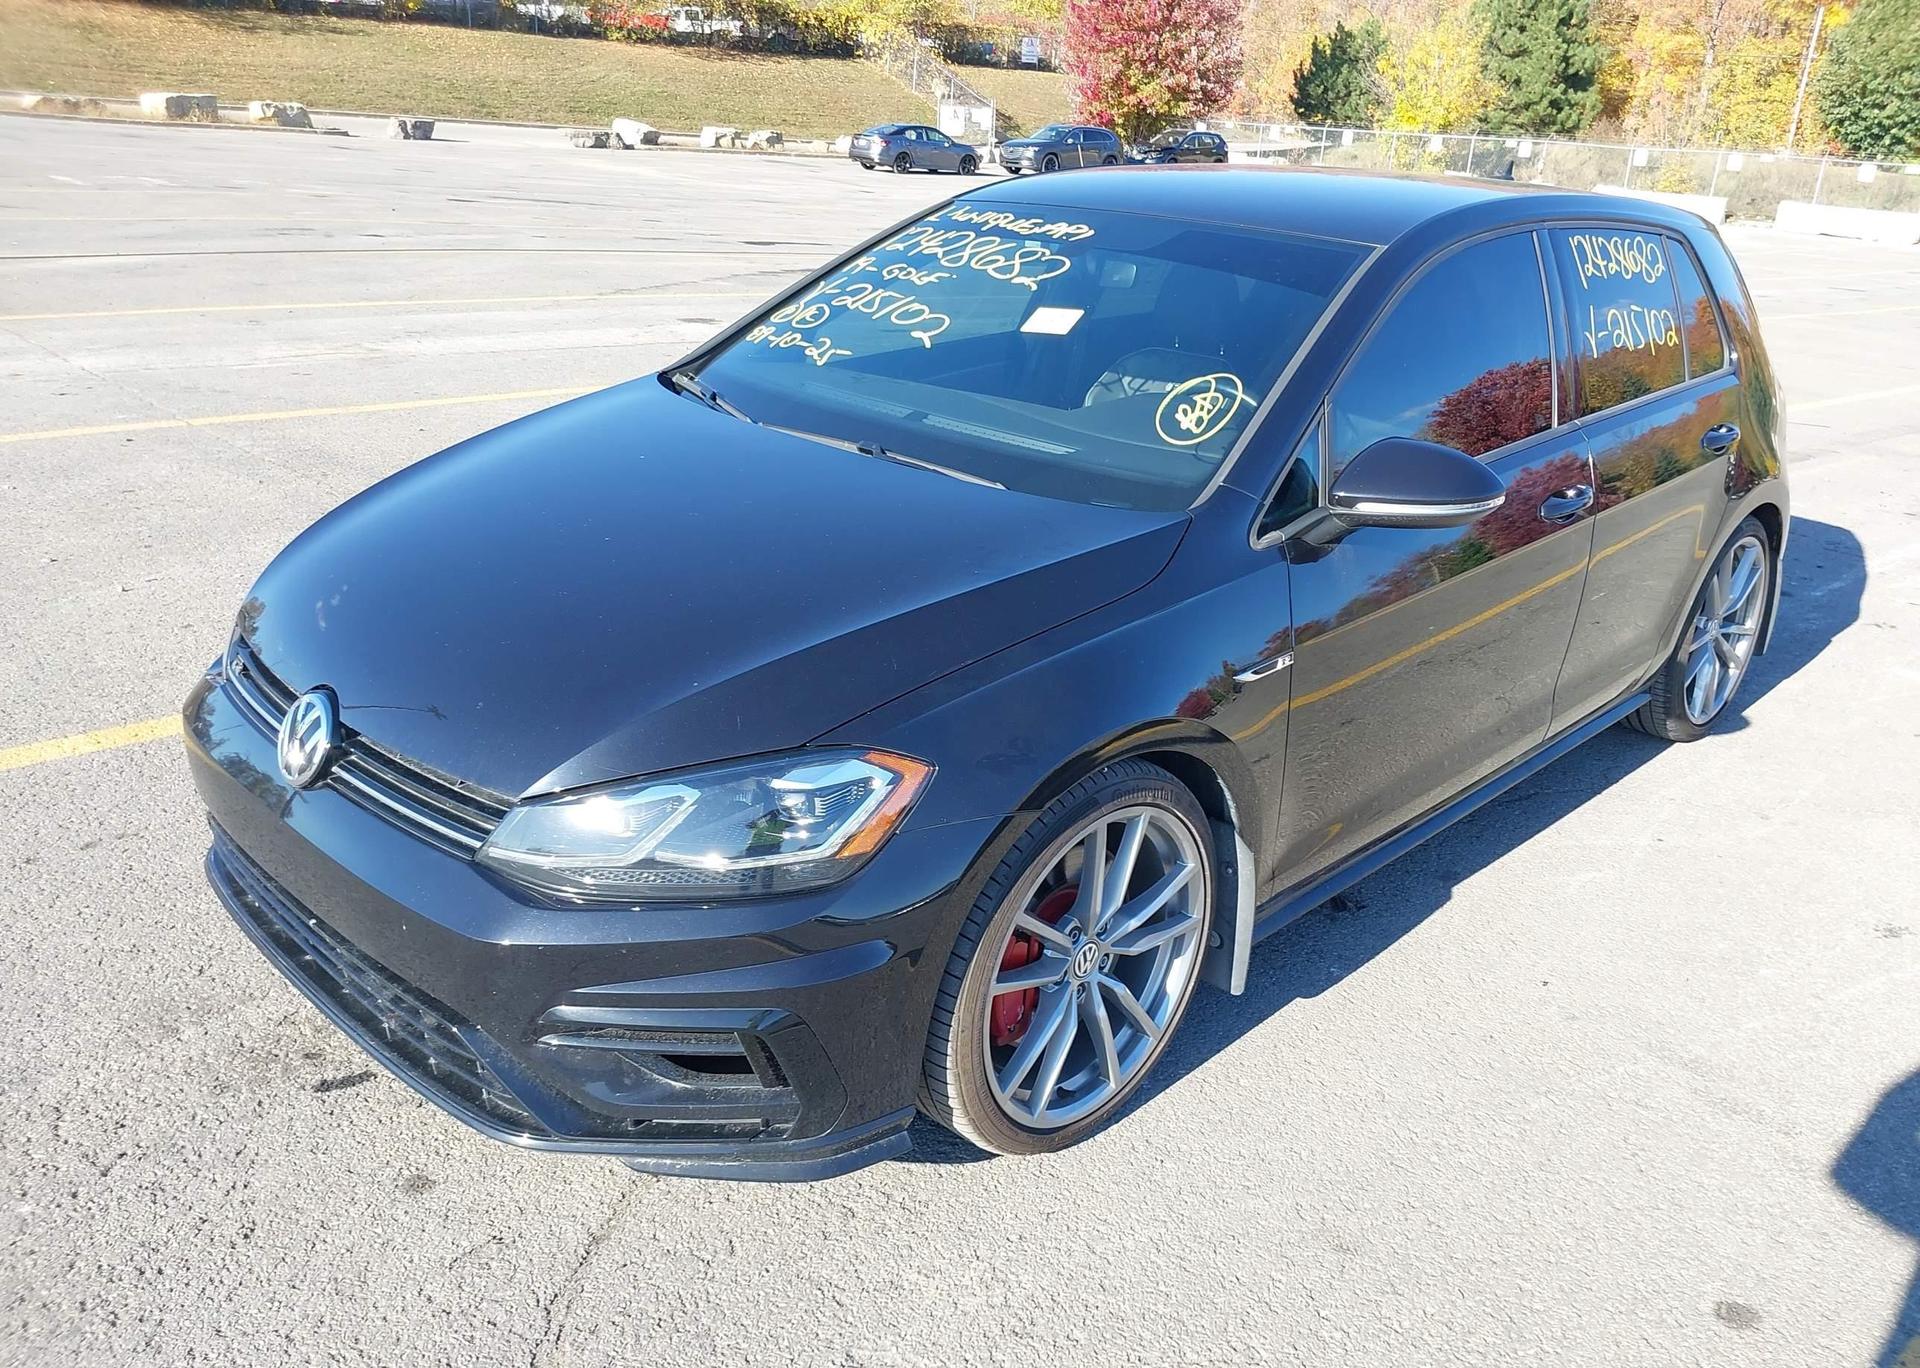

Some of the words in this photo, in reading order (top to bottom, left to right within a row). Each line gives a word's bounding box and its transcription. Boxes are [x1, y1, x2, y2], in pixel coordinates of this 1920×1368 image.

[872, 226, 1072, 291] 12428682
[1569, 234, 1667, 289] 12428682
[1112, 784, 1175, 803] Continental
